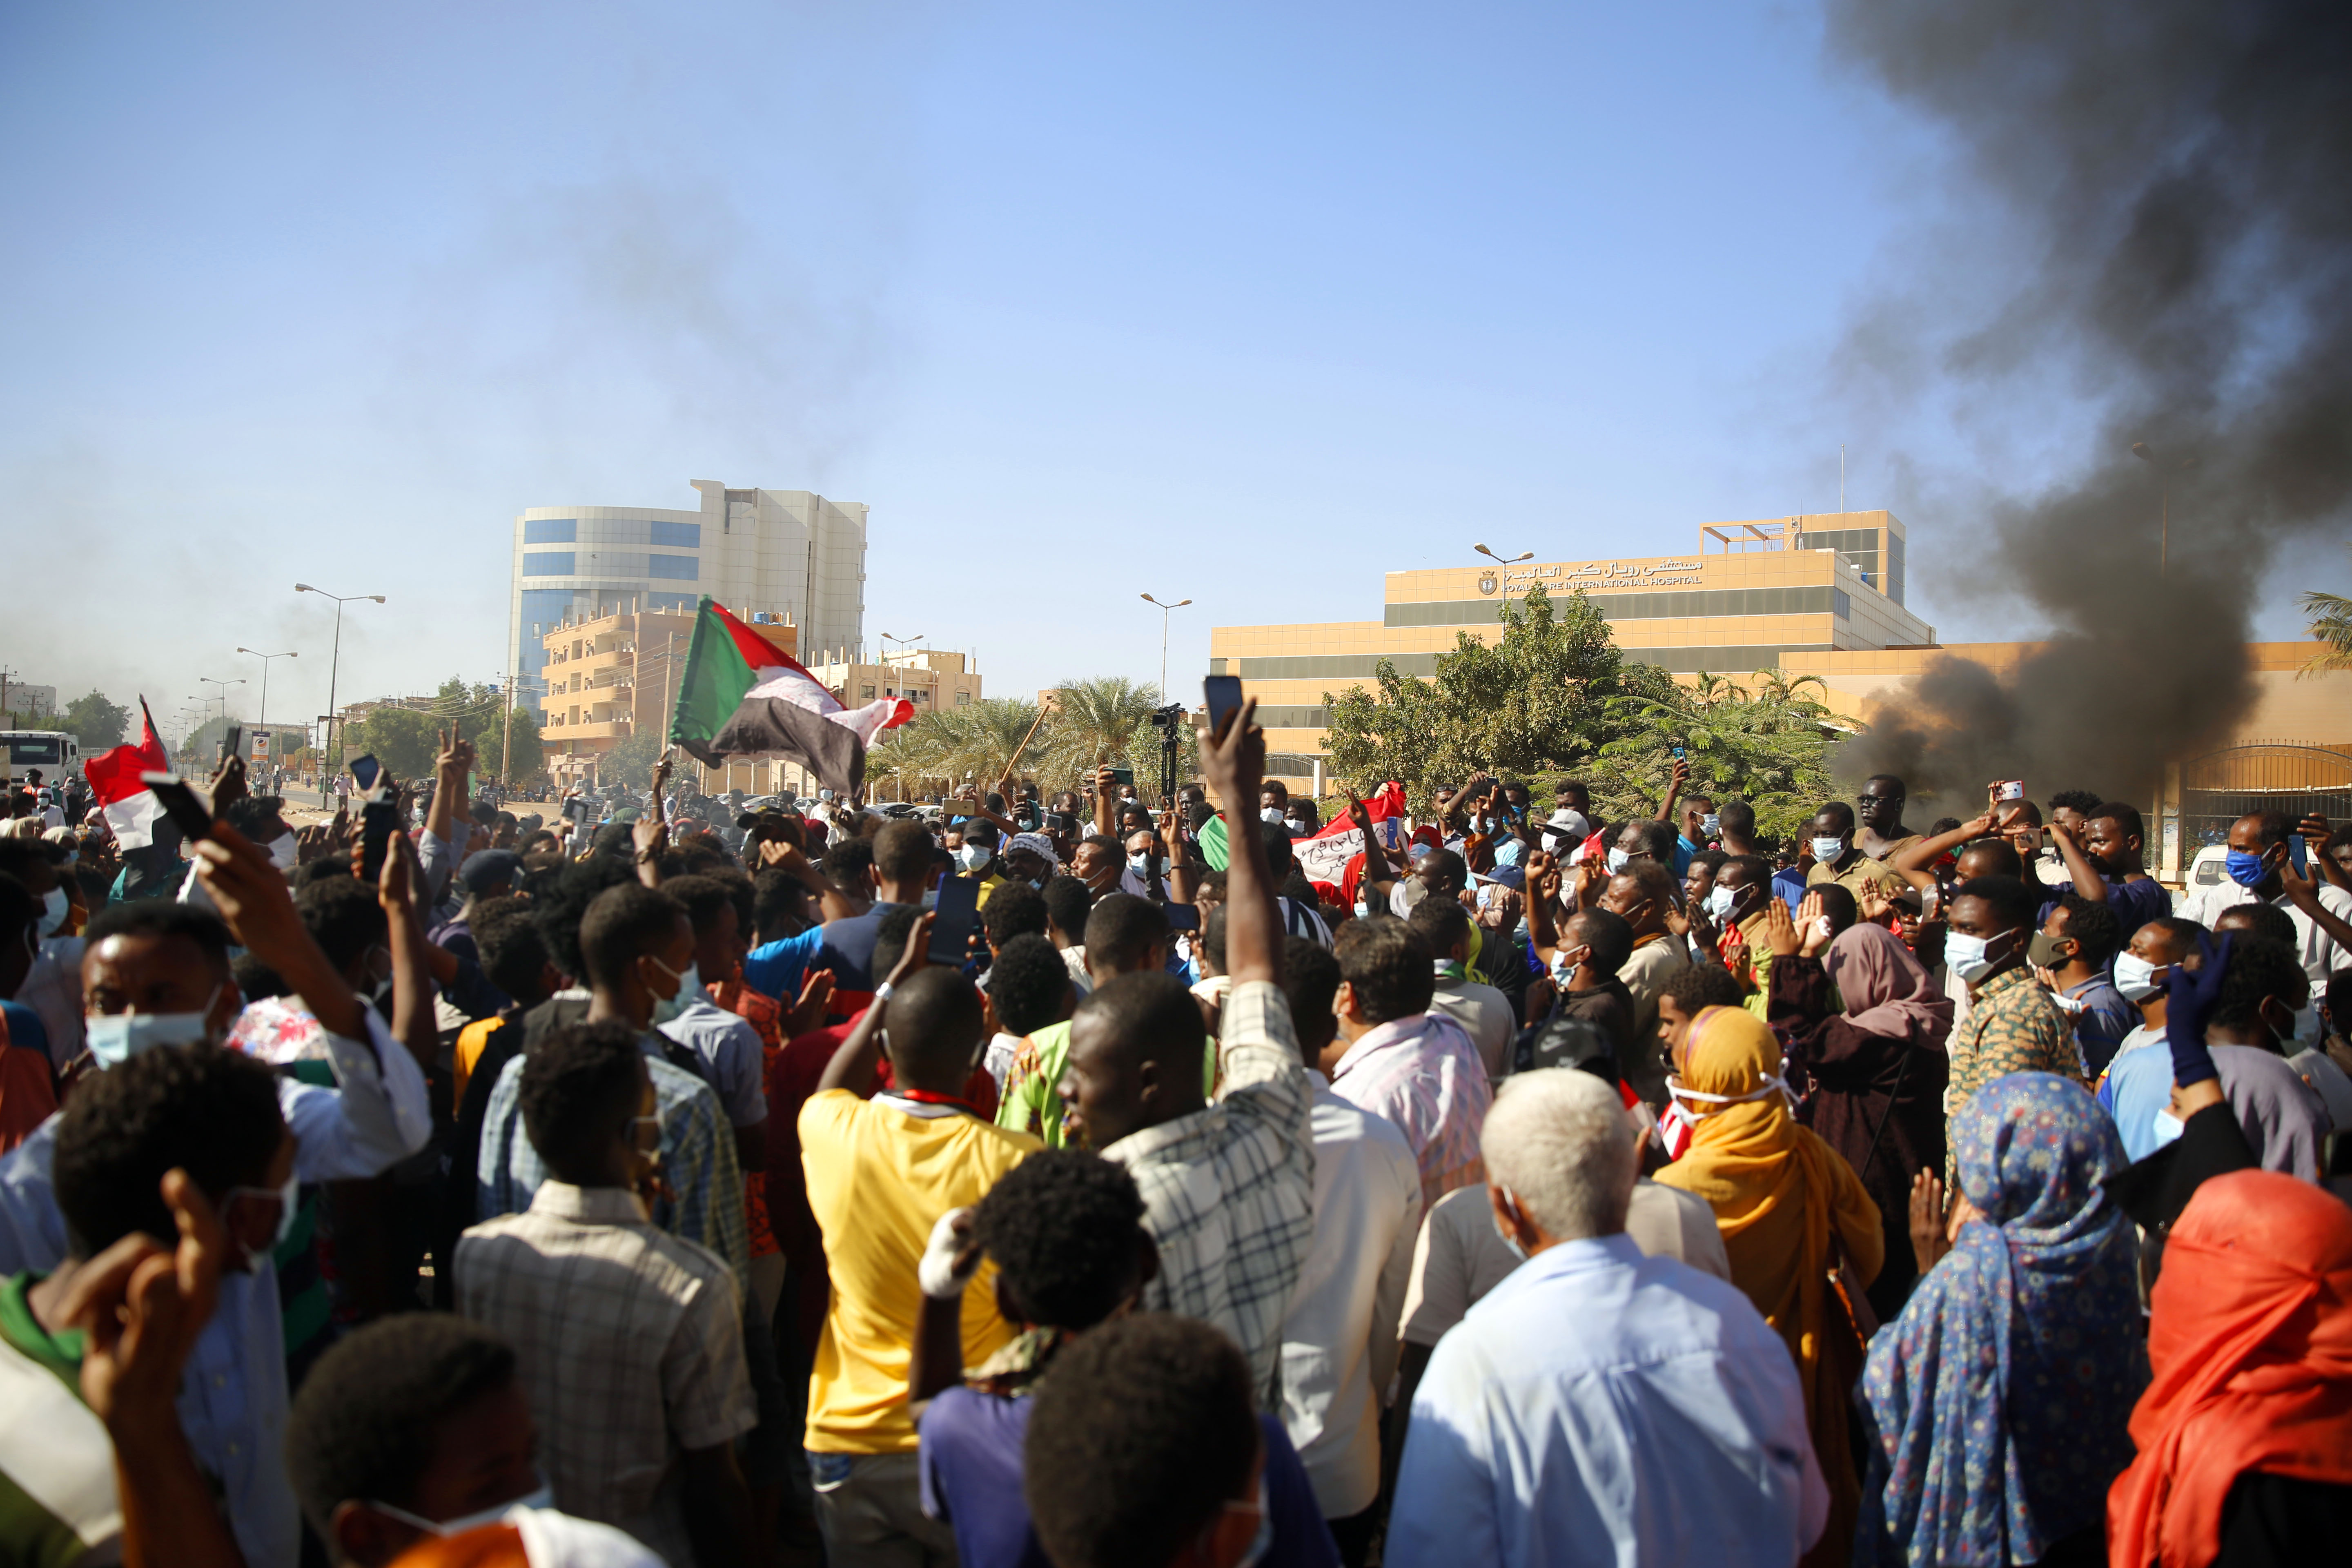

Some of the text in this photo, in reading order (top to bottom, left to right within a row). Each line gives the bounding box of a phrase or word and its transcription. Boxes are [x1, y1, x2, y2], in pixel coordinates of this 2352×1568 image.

[1505, 559, 1703, 582] مستشفى رويال كير العالمية
[1537, 582, 1563, 590] ARE
[1565, 578, 1648, 590] INTERNATIONAL
[1650, 576, 1702, 586] HOSPITAL
